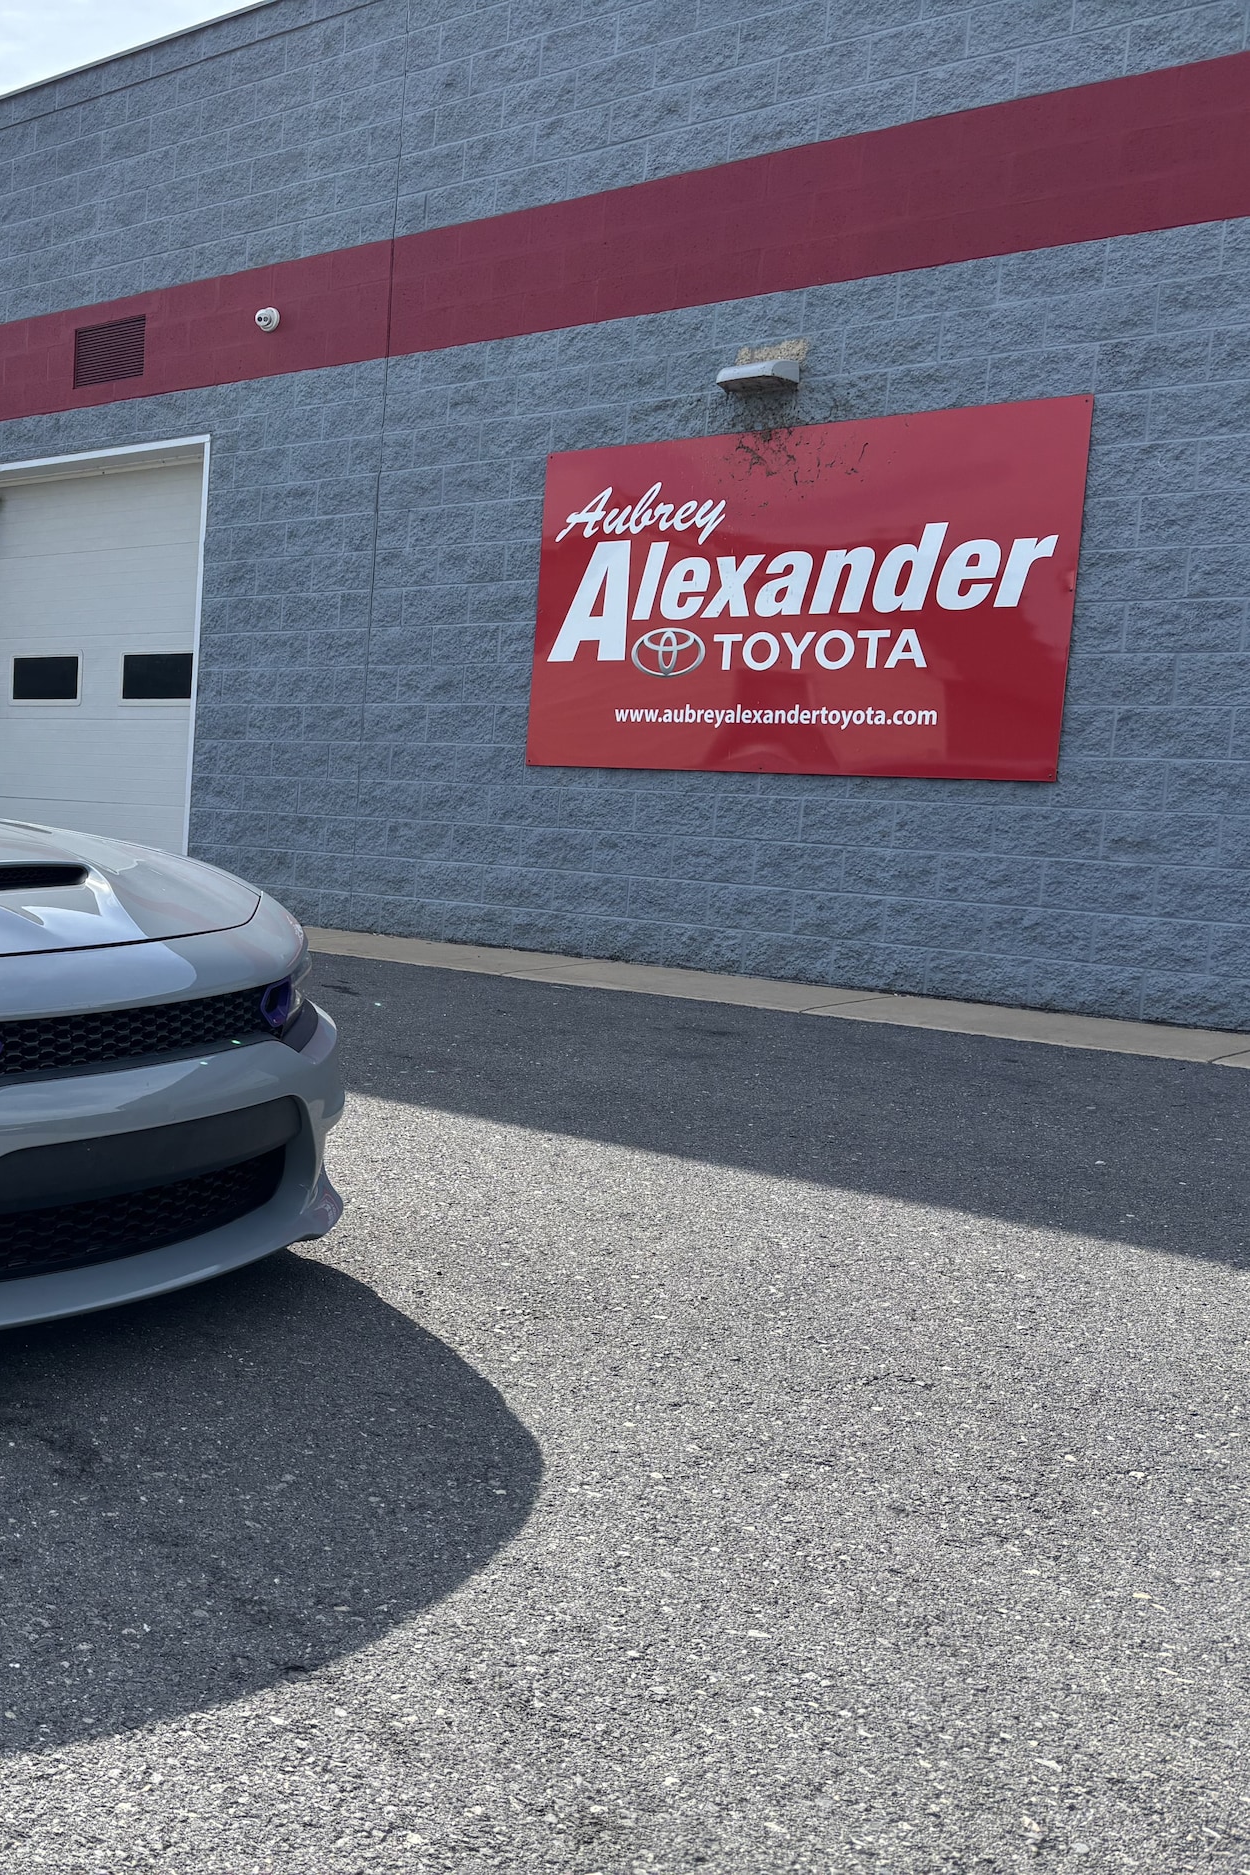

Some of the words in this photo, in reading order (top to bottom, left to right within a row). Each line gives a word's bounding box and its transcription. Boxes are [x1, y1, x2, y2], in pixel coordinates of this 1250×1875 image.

[555, 481, 726, 546] Aubrey
[546, 521, 1059, 662] Alexander
[713, 628, 928, 671] TOYOTA
[614, 703, 938, 730] www.aubreyalexandertoyota.com
